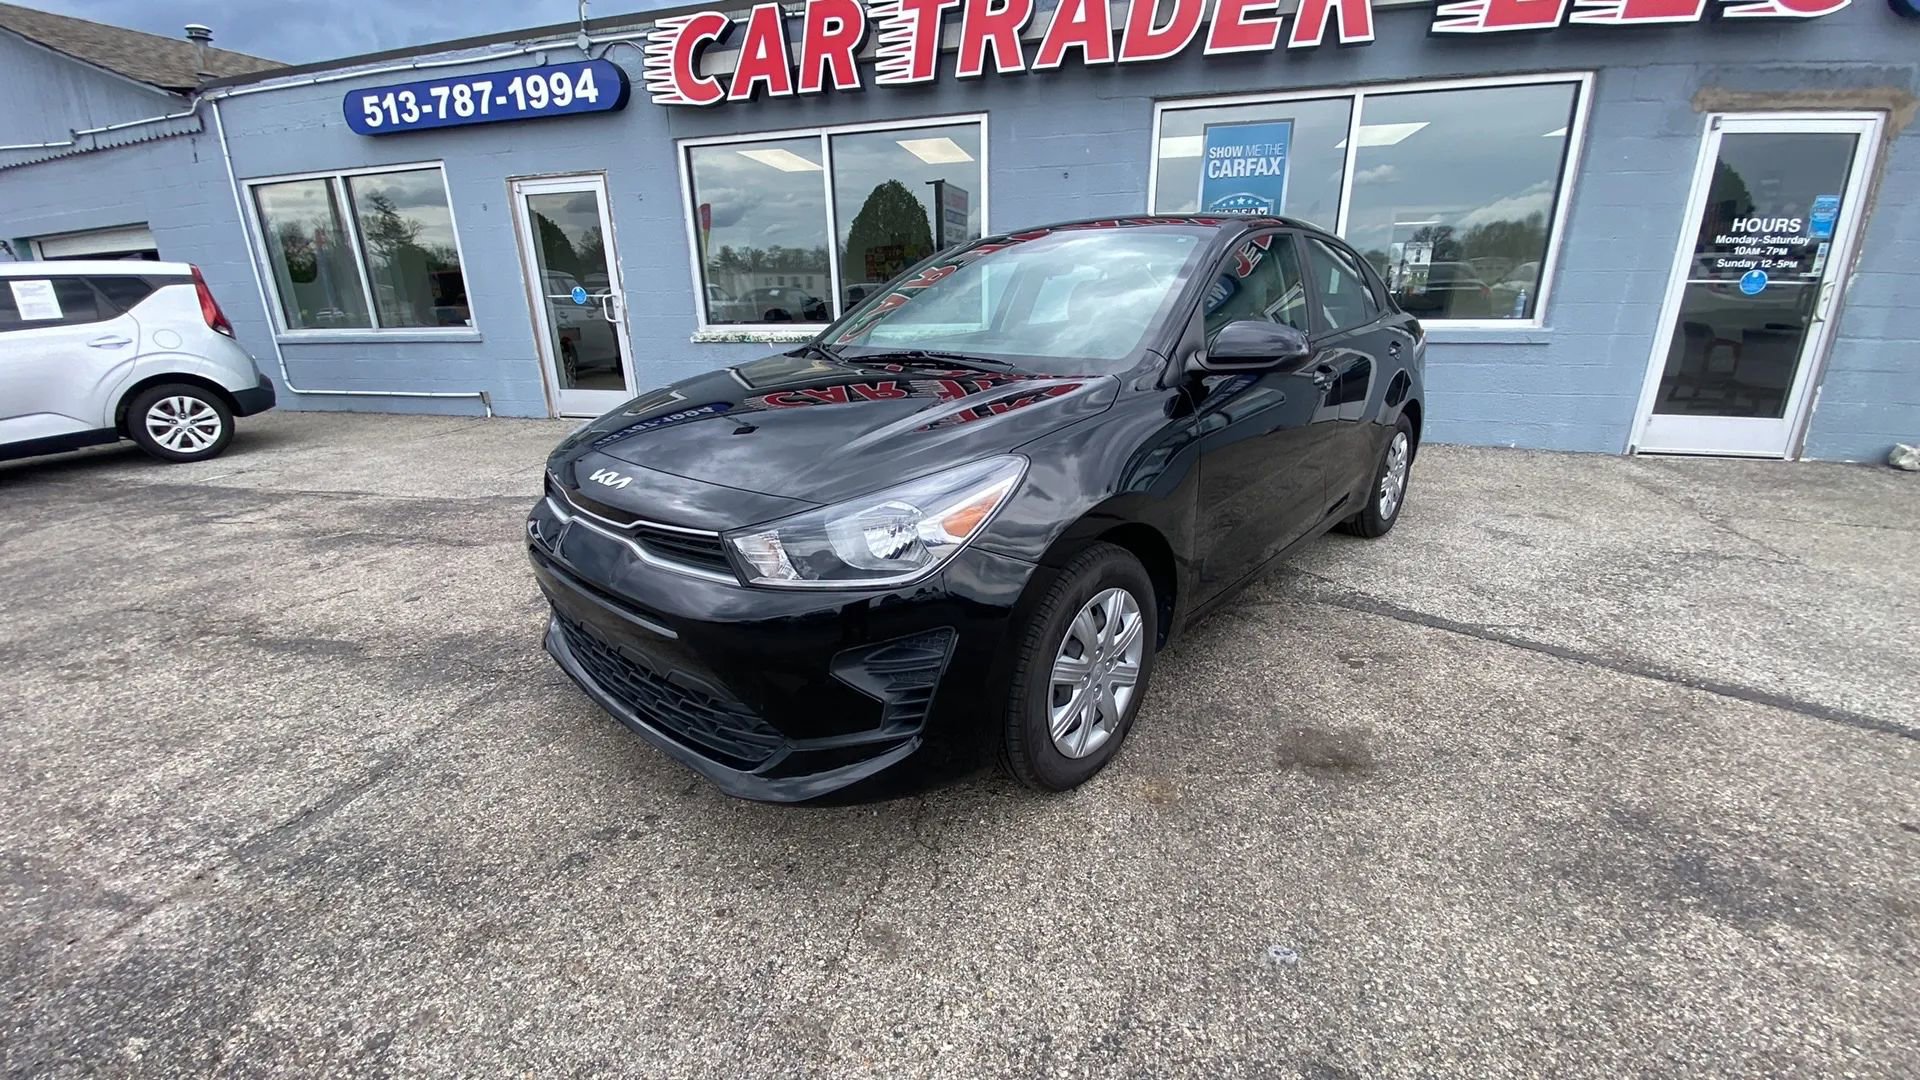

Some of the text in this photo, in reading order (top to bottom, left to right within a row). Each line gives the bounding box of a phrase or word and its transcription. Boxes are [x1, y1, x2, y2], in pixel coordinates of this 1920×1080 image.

[643, 0, 864, 105] CAR
[362, 68, 599, 127] 513-787-1994
[1209, 143, 1285, 158] SHOW ME THE
[1208, 157, 1282, 178] CARFAX
[1731, 218, 1802, 233] HOURS
[1715, 235, 1810, 246] Monday-Saturday
[1716, 258, 1798, 269] Sunday 12-5PM
